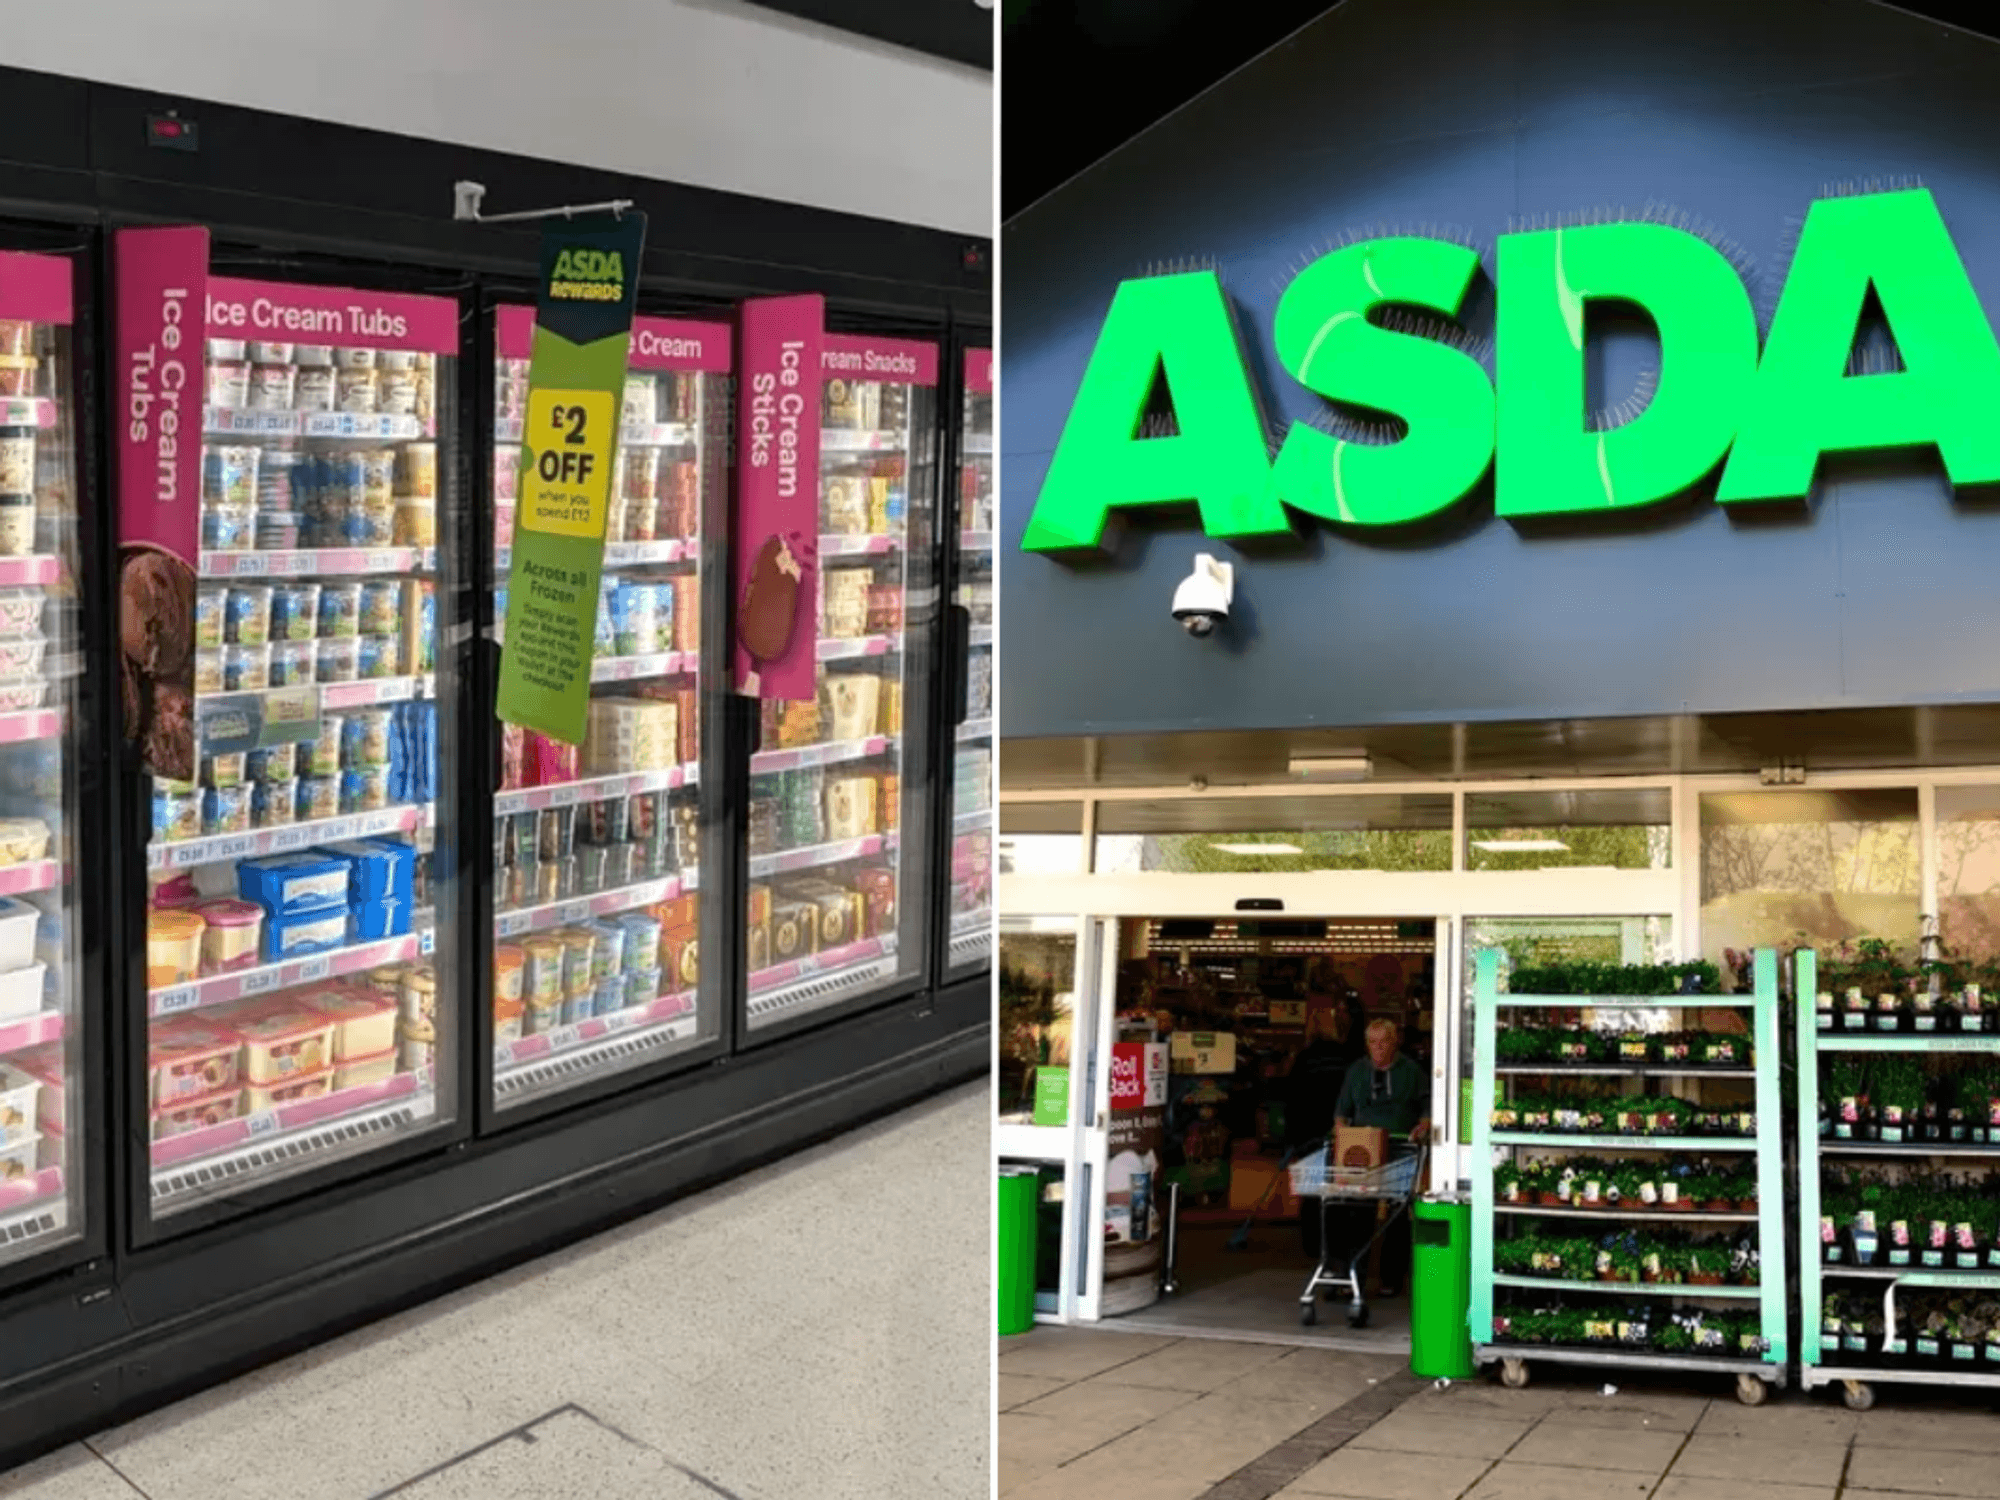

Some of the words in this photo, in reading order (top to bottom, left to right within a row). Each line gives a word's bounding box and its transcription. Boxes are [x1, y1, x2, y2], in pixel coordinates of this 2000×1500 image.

[552, 250, 624, 282] ASDA
[161, 288, 187, 350] Ice
[205, 293, 247, 326] Ice
[251, 298, 343, 332] Cream
[346, 306, 408, 338] Tubs
[638, 329, 703, 359] Cream
[780, 341, 805, 387] Ice
[821, 351, 862, 371] ream
[864, 350, 917, 375] Snacks
[1020, 187, 2000, 551] ASDA
[130, 343, 156, 442] Tubs
[157, 363, 186, 501] Cream
[552, 405, 587, 446] £2
[751, 372, 777, 468] Sticks
[777, 393, 805, 498] Cream
[538, 449, 594, 485] OFF
[538, 489, 567, 503] when
[570, 493, 591, 507] you
[522, 559, 567, 583] Across
[570, 570, 588, 589] all
[530, 579, 575, 603] Frozen
[1111, 1055, 1138, 1077] Roll
